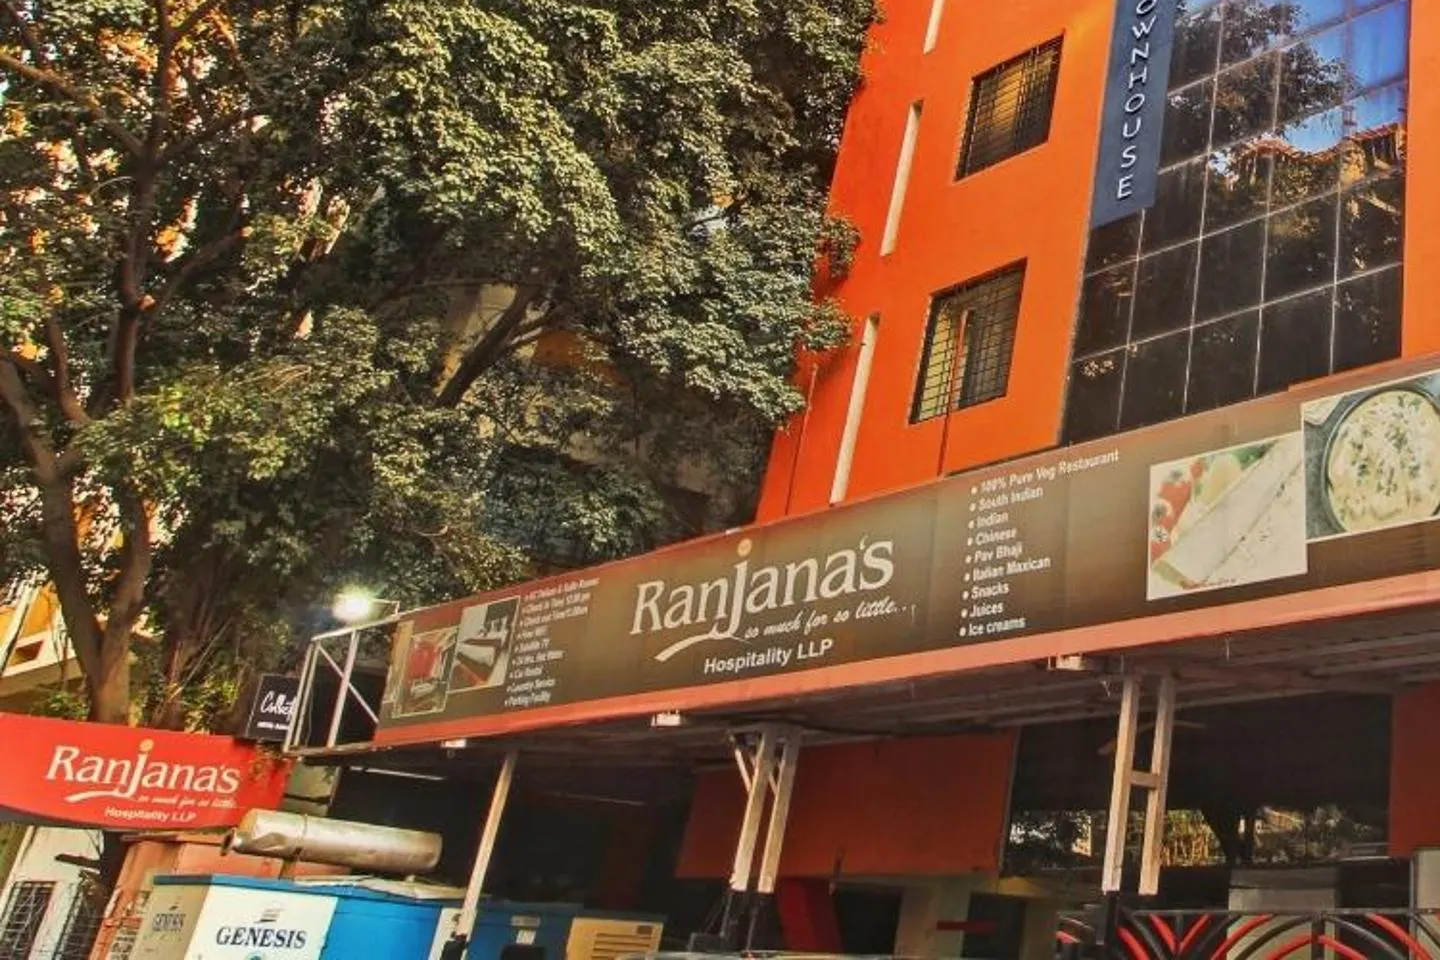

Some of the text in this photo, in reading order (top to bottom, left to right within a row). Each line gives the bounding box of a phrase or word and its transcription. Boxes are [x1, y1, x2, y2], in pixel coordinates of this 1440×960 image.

[1009, 472, 1033, 487] Pure
[1036, 466, 1057, 481] Veg
[1059, 448, 1119, 474] Restaurant
[979, 487, 1043, 511] South Indian
[977, 512, 1009, 528] Indian
[975, 527, 1017, 546] Chinese
[974, 541, 1023, 563] Pav Bhaji
[973, 565, 1004, 581] Italian
[629, 535, 894, 639] Ranjana's
[971, 582, 1010, 600] Snacks
[969, 601, 1004, 618] Juices
[744, 627, 759, 639] so
[763, 611, 803, 636] much
[804, 610, 828, 636] for
[833, 609, 850, 623] so
[968, 617, 1027, 637] Ice creams
[703, 638, 834, 674] Hospitality LLP
[46, 738, 241, 797] Ranjana's
[105, 806, 169, 823] Hospitality
[216, 926, 307, 949] GENESIS
